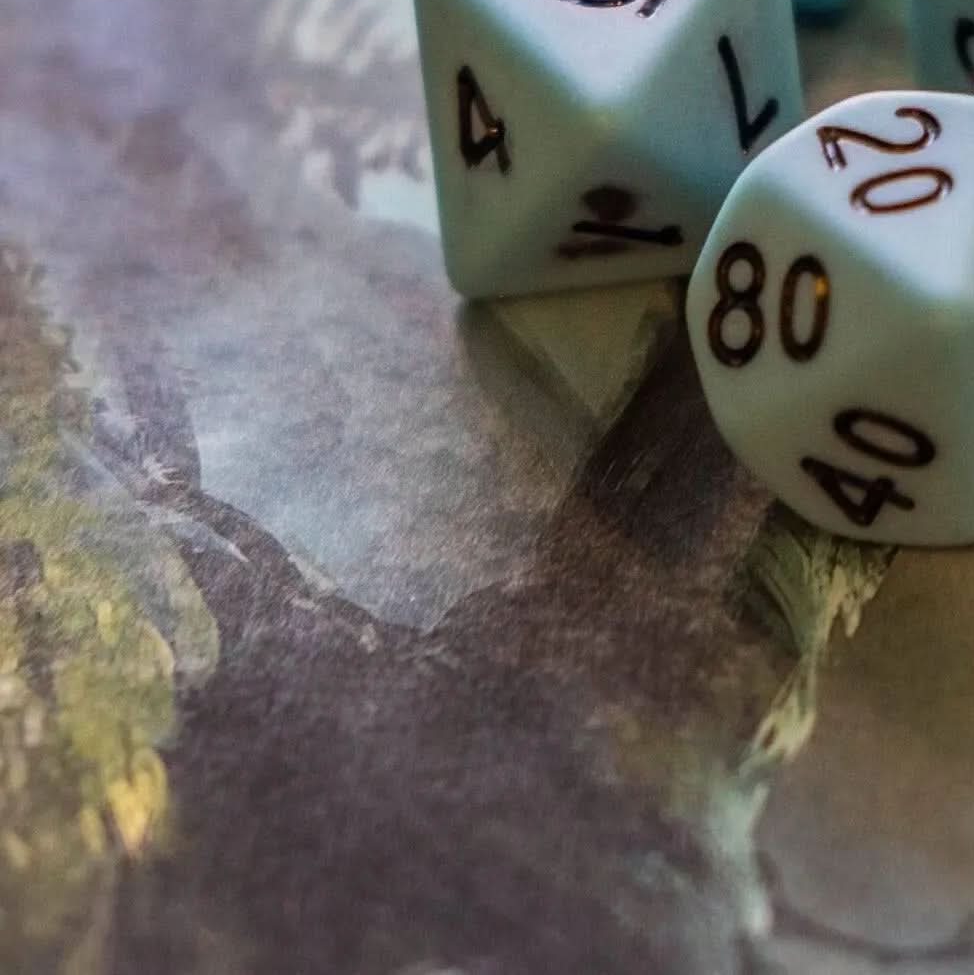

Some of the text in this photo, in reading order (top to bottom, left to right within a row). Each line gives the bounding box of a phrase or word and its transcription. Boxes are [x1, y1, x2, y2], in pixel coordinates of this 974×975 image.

[457, 65, 512, 175] 4
[718, 35, 779, 156] 7
[815, 106, 955, 215] 20
[708, 241, 831, 367] 80
[801, 408, 936, 526] 40
